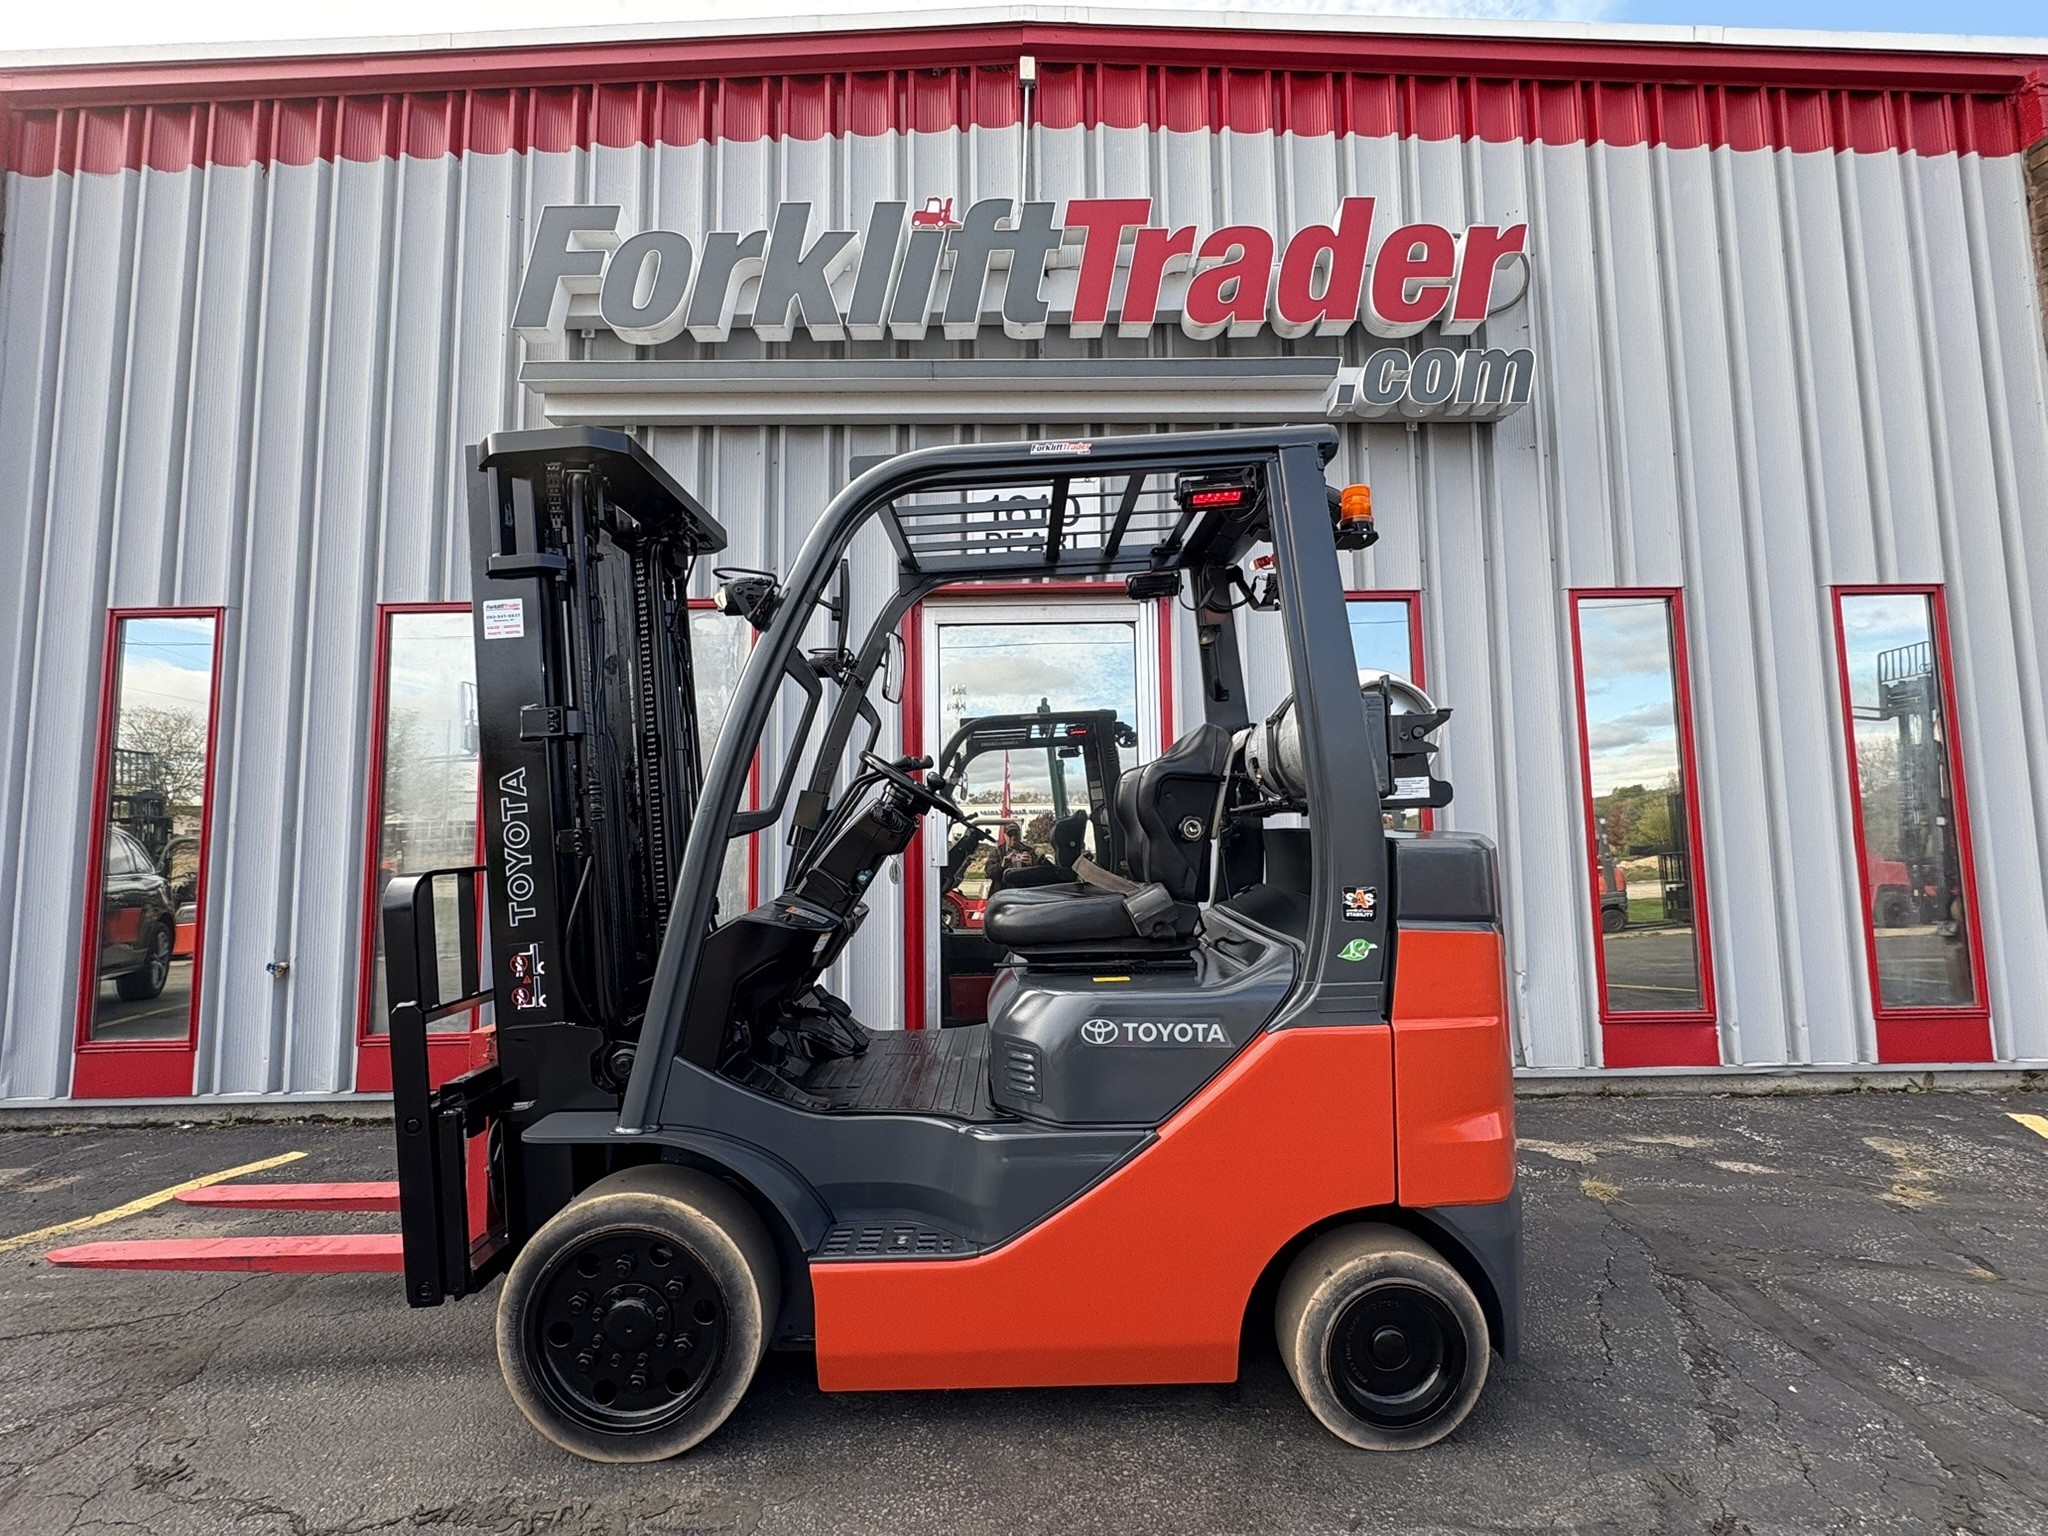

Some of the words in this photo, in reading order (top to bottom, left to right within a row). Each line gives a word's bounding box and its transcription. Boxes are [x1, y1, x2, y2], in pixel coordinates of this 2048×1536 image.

[511, 195, 1529, 335] ForkliftTrader
[1336, 347, 1536, 408] .com
[1031, 442, 1091, 452] ForkliftTrader
[499, 766, 537, 928] TOYOTA
[1345, 890, 1374, 908] SAS
[1122, 1022, 1226, 1043] TOYOTA
